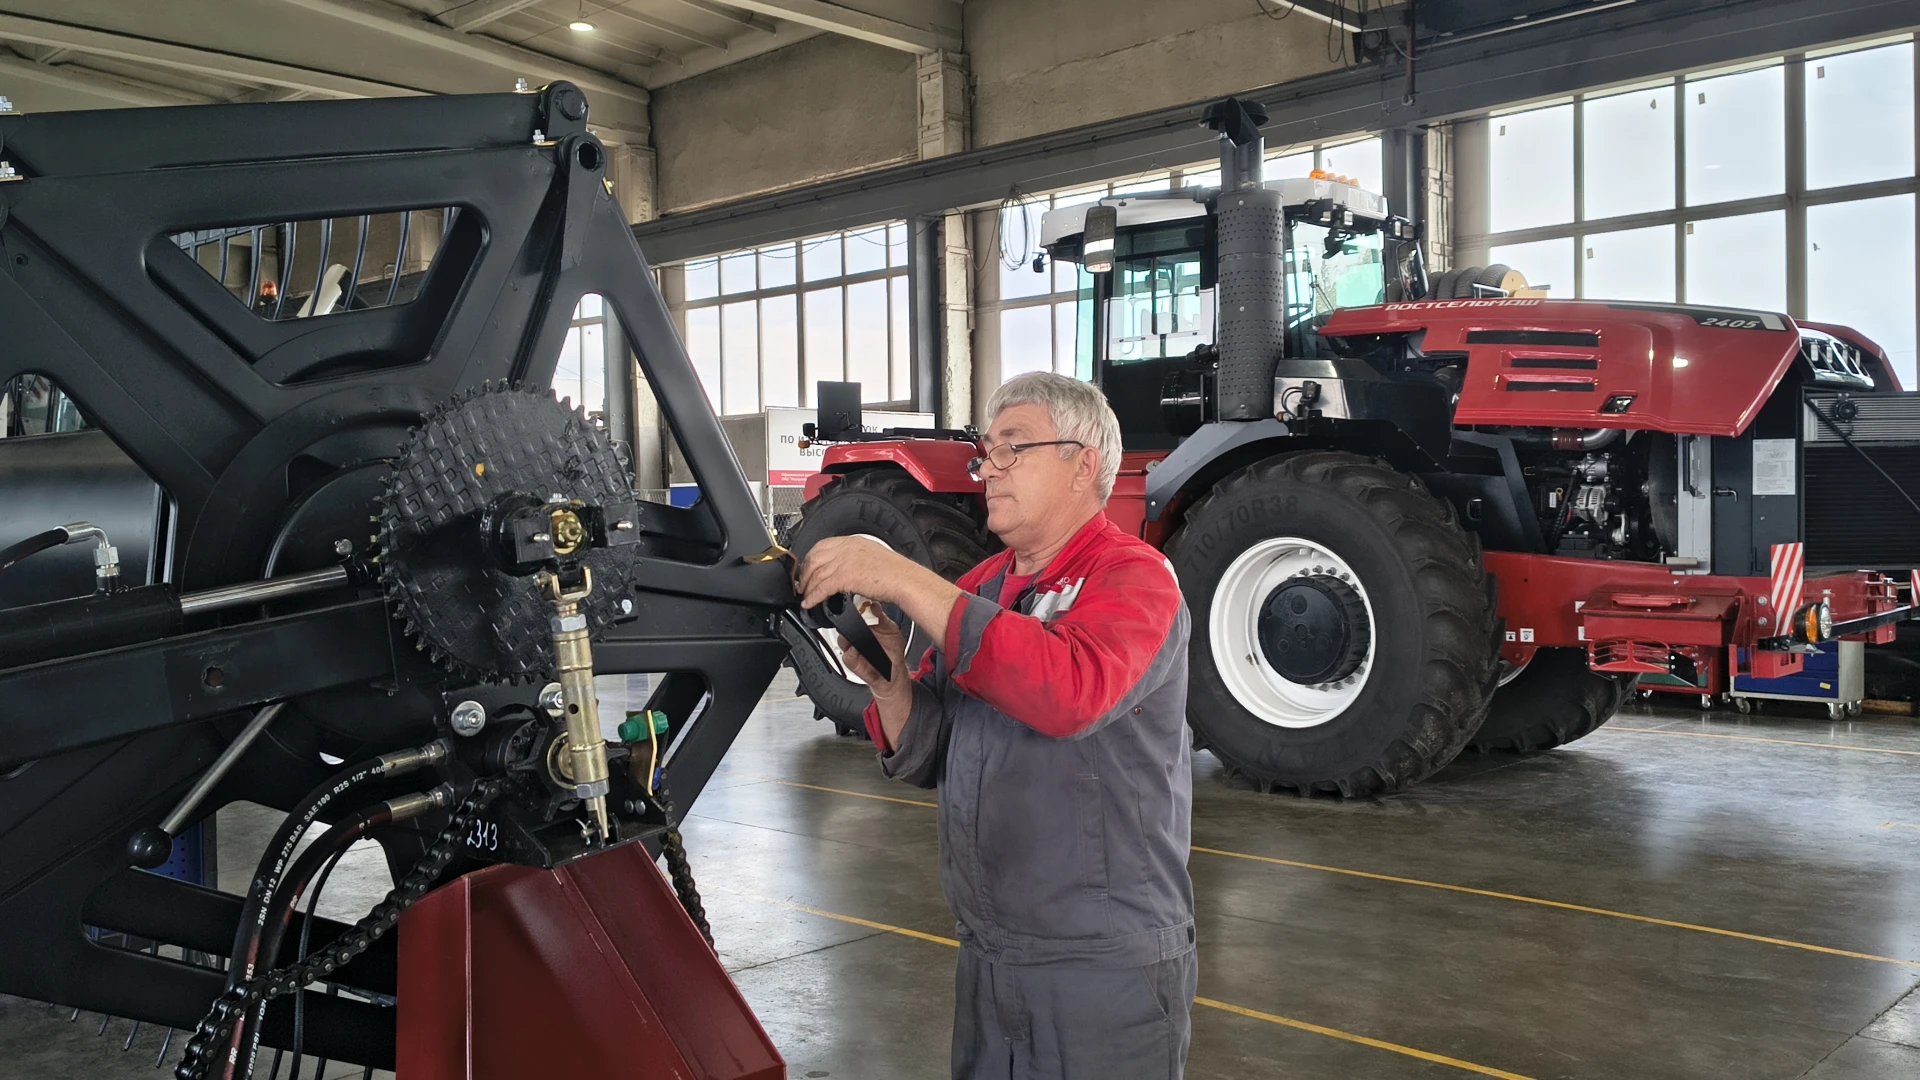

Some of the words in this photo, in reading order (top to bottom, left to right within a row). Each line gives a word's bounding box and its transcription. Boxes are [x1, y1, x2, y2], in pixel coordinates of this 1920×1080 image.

[1385, 300, 1541, 312] РОСТСЕЛЬМАШ
[1699, 317, 1761, 329] 2405
[780, 435, 795, 444] ПО
[1184, 494, 1299, 573] 710/70R38
[333, 780, 350, 795] R2S
[317, 793, 331, 807] 100
[304, 805, 319, 822] SAE
[289, 824, 304, 843] BAR
[281, 842, 292, 858] 275
[274, 858, 284, 874] WP
[268, 878, 277, 889] 12
[263, 889, 274, 904] DN
[257, 906, 267, 926] 2SN
[252, 1032, 260, 1050] PSI
[228, 1046, 238, 1065] RR
